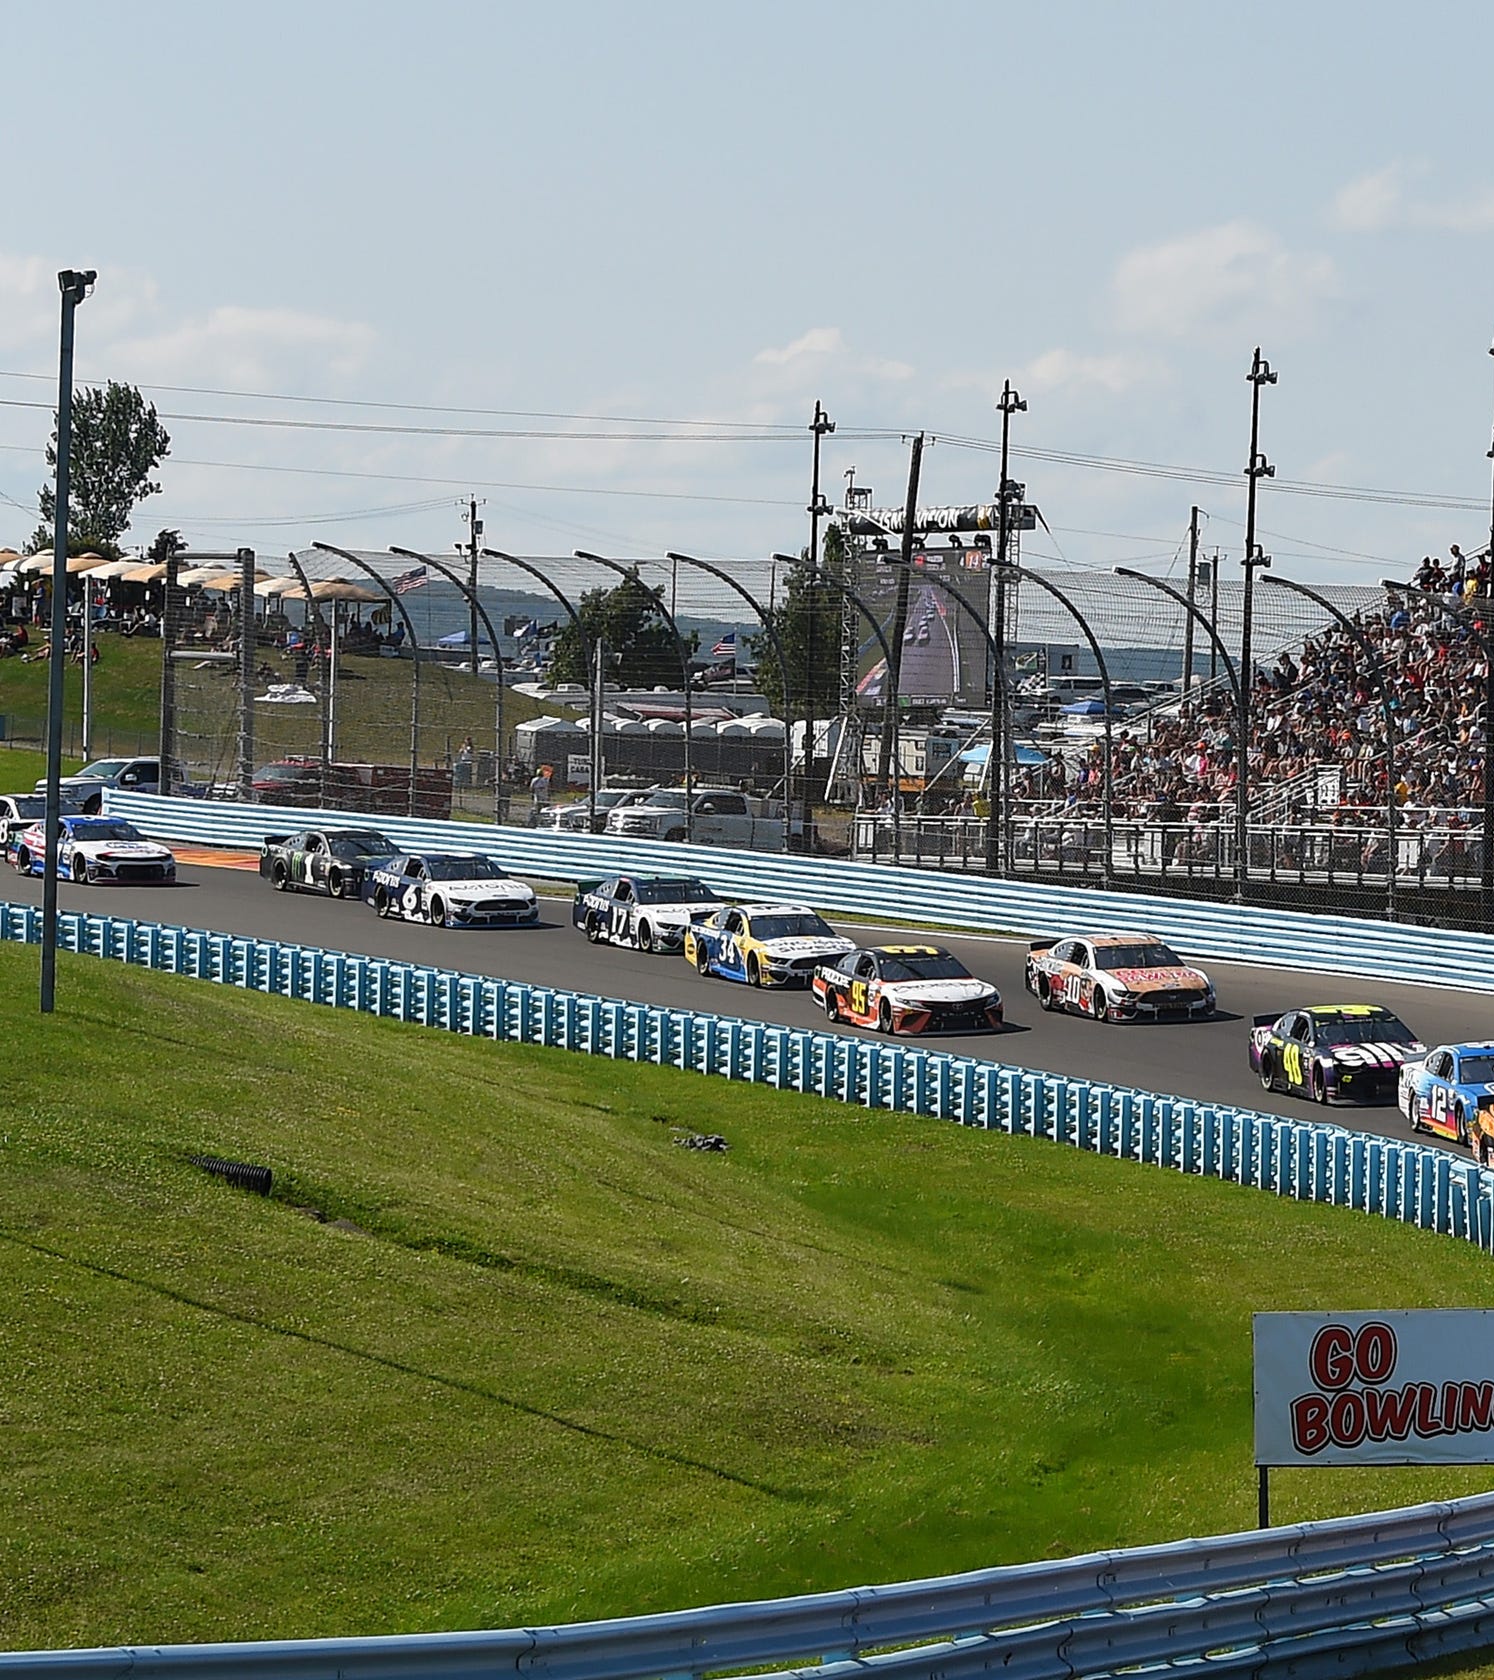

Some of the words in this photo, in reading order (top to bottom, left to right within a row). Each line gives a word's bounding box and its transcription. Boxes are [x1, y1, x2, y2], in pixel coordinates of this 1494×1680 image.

[304, 853, 314, 884] 1
[402, 884, 418, 910] 6
[611, 905, 628, 935] 17
[718, 933, 736, 965] 34
[851, 980, 867, 1014] 95
[1066, 975, 1081, 1004] 10
[1283, 1042, 1303, 1085] 48
[1431, 1084, 1447, 1124] 12
[1309, 1320, 1398, 1394] GO
